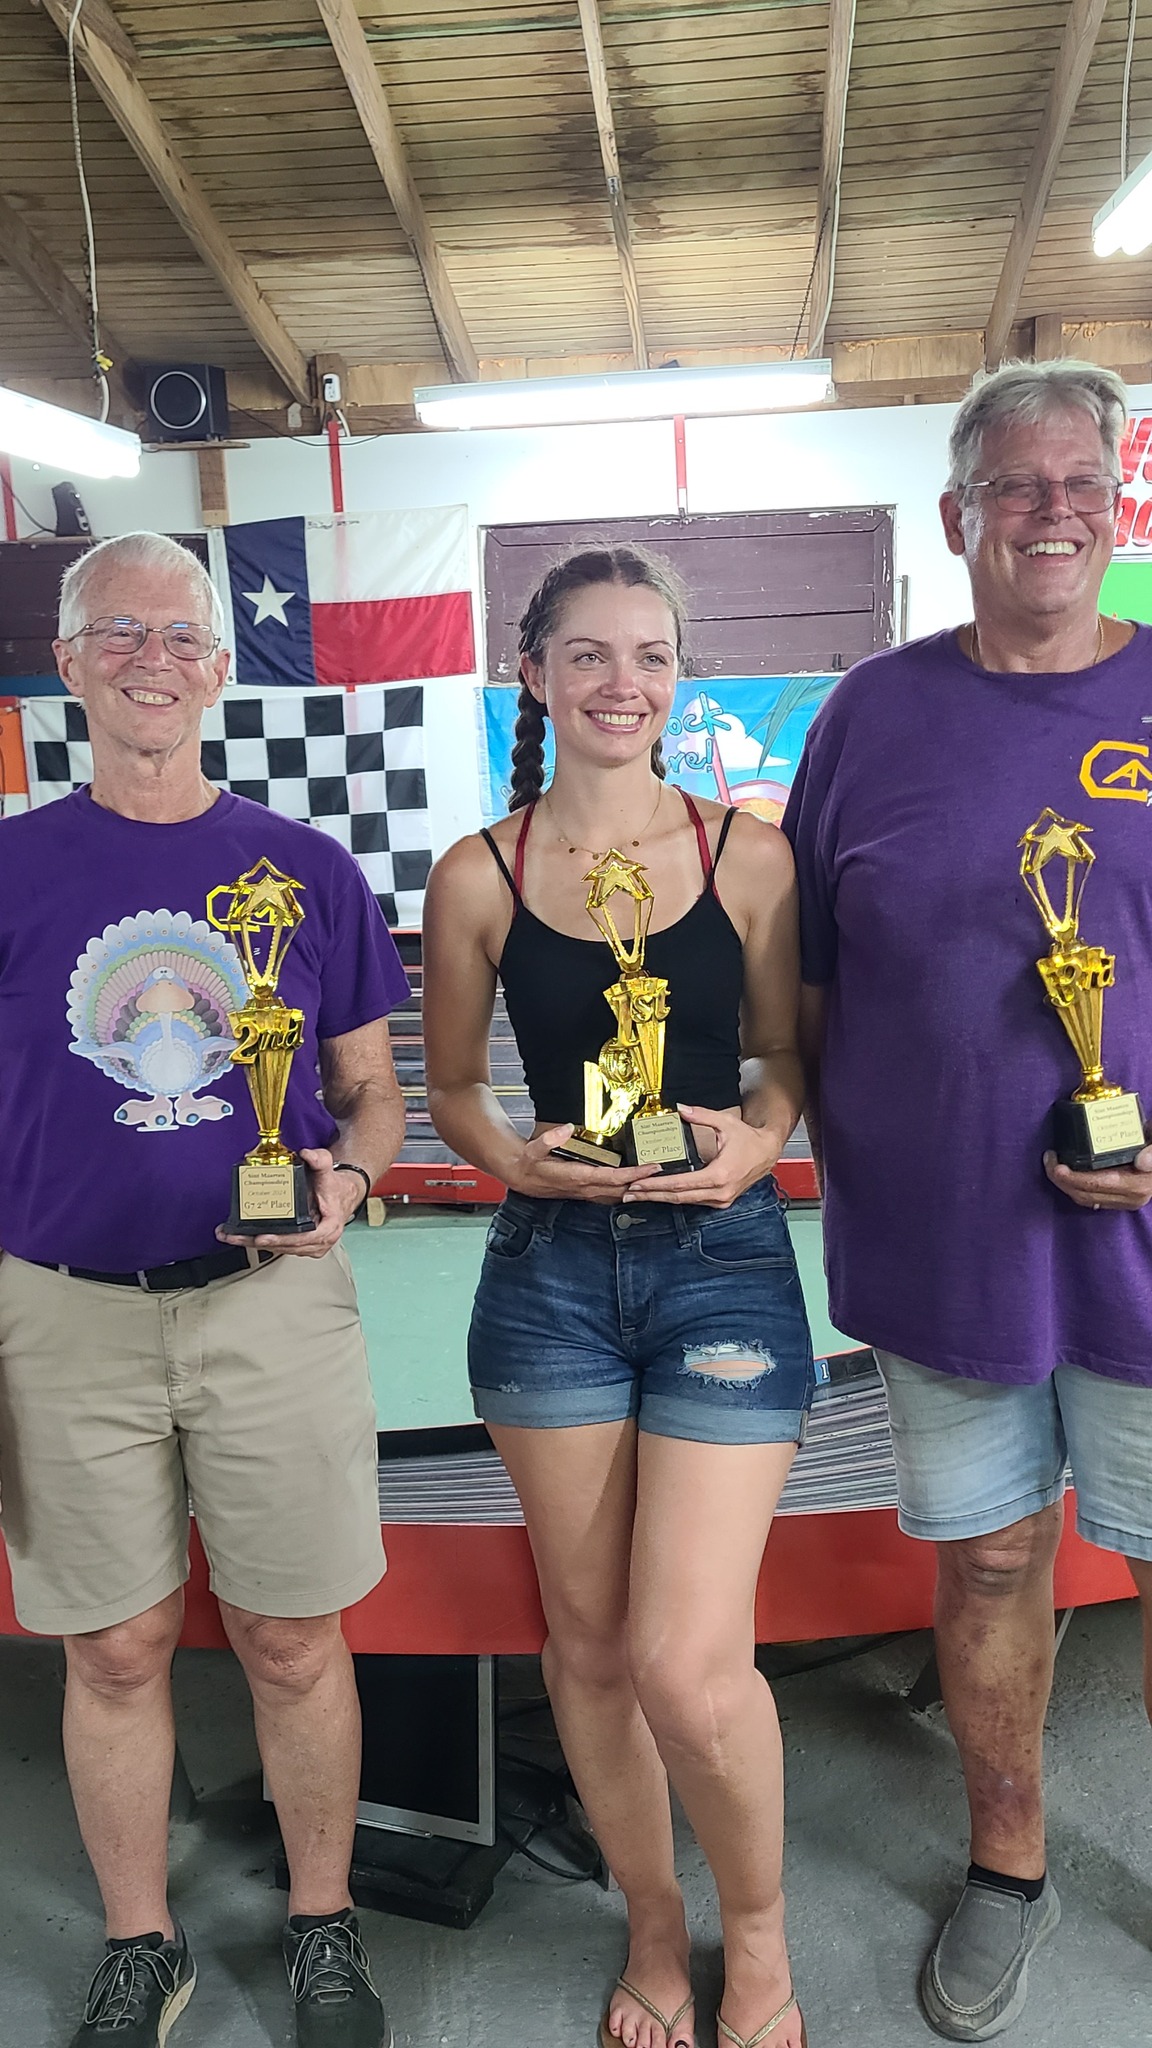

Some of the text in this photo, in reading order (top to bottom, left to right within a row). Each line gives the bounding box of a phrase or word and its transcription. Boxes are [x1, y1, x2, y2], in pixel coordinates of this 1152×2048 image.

[662, 691, 731, 737] ock
[609, 986, 672, 1050] 1st
[228, 1015, 305, 1064] 2nd
[661, 1145, 681, 1154] Place
[270, 1200, 290, 1209] Place
[821, 1363, 829, 1380] 1
